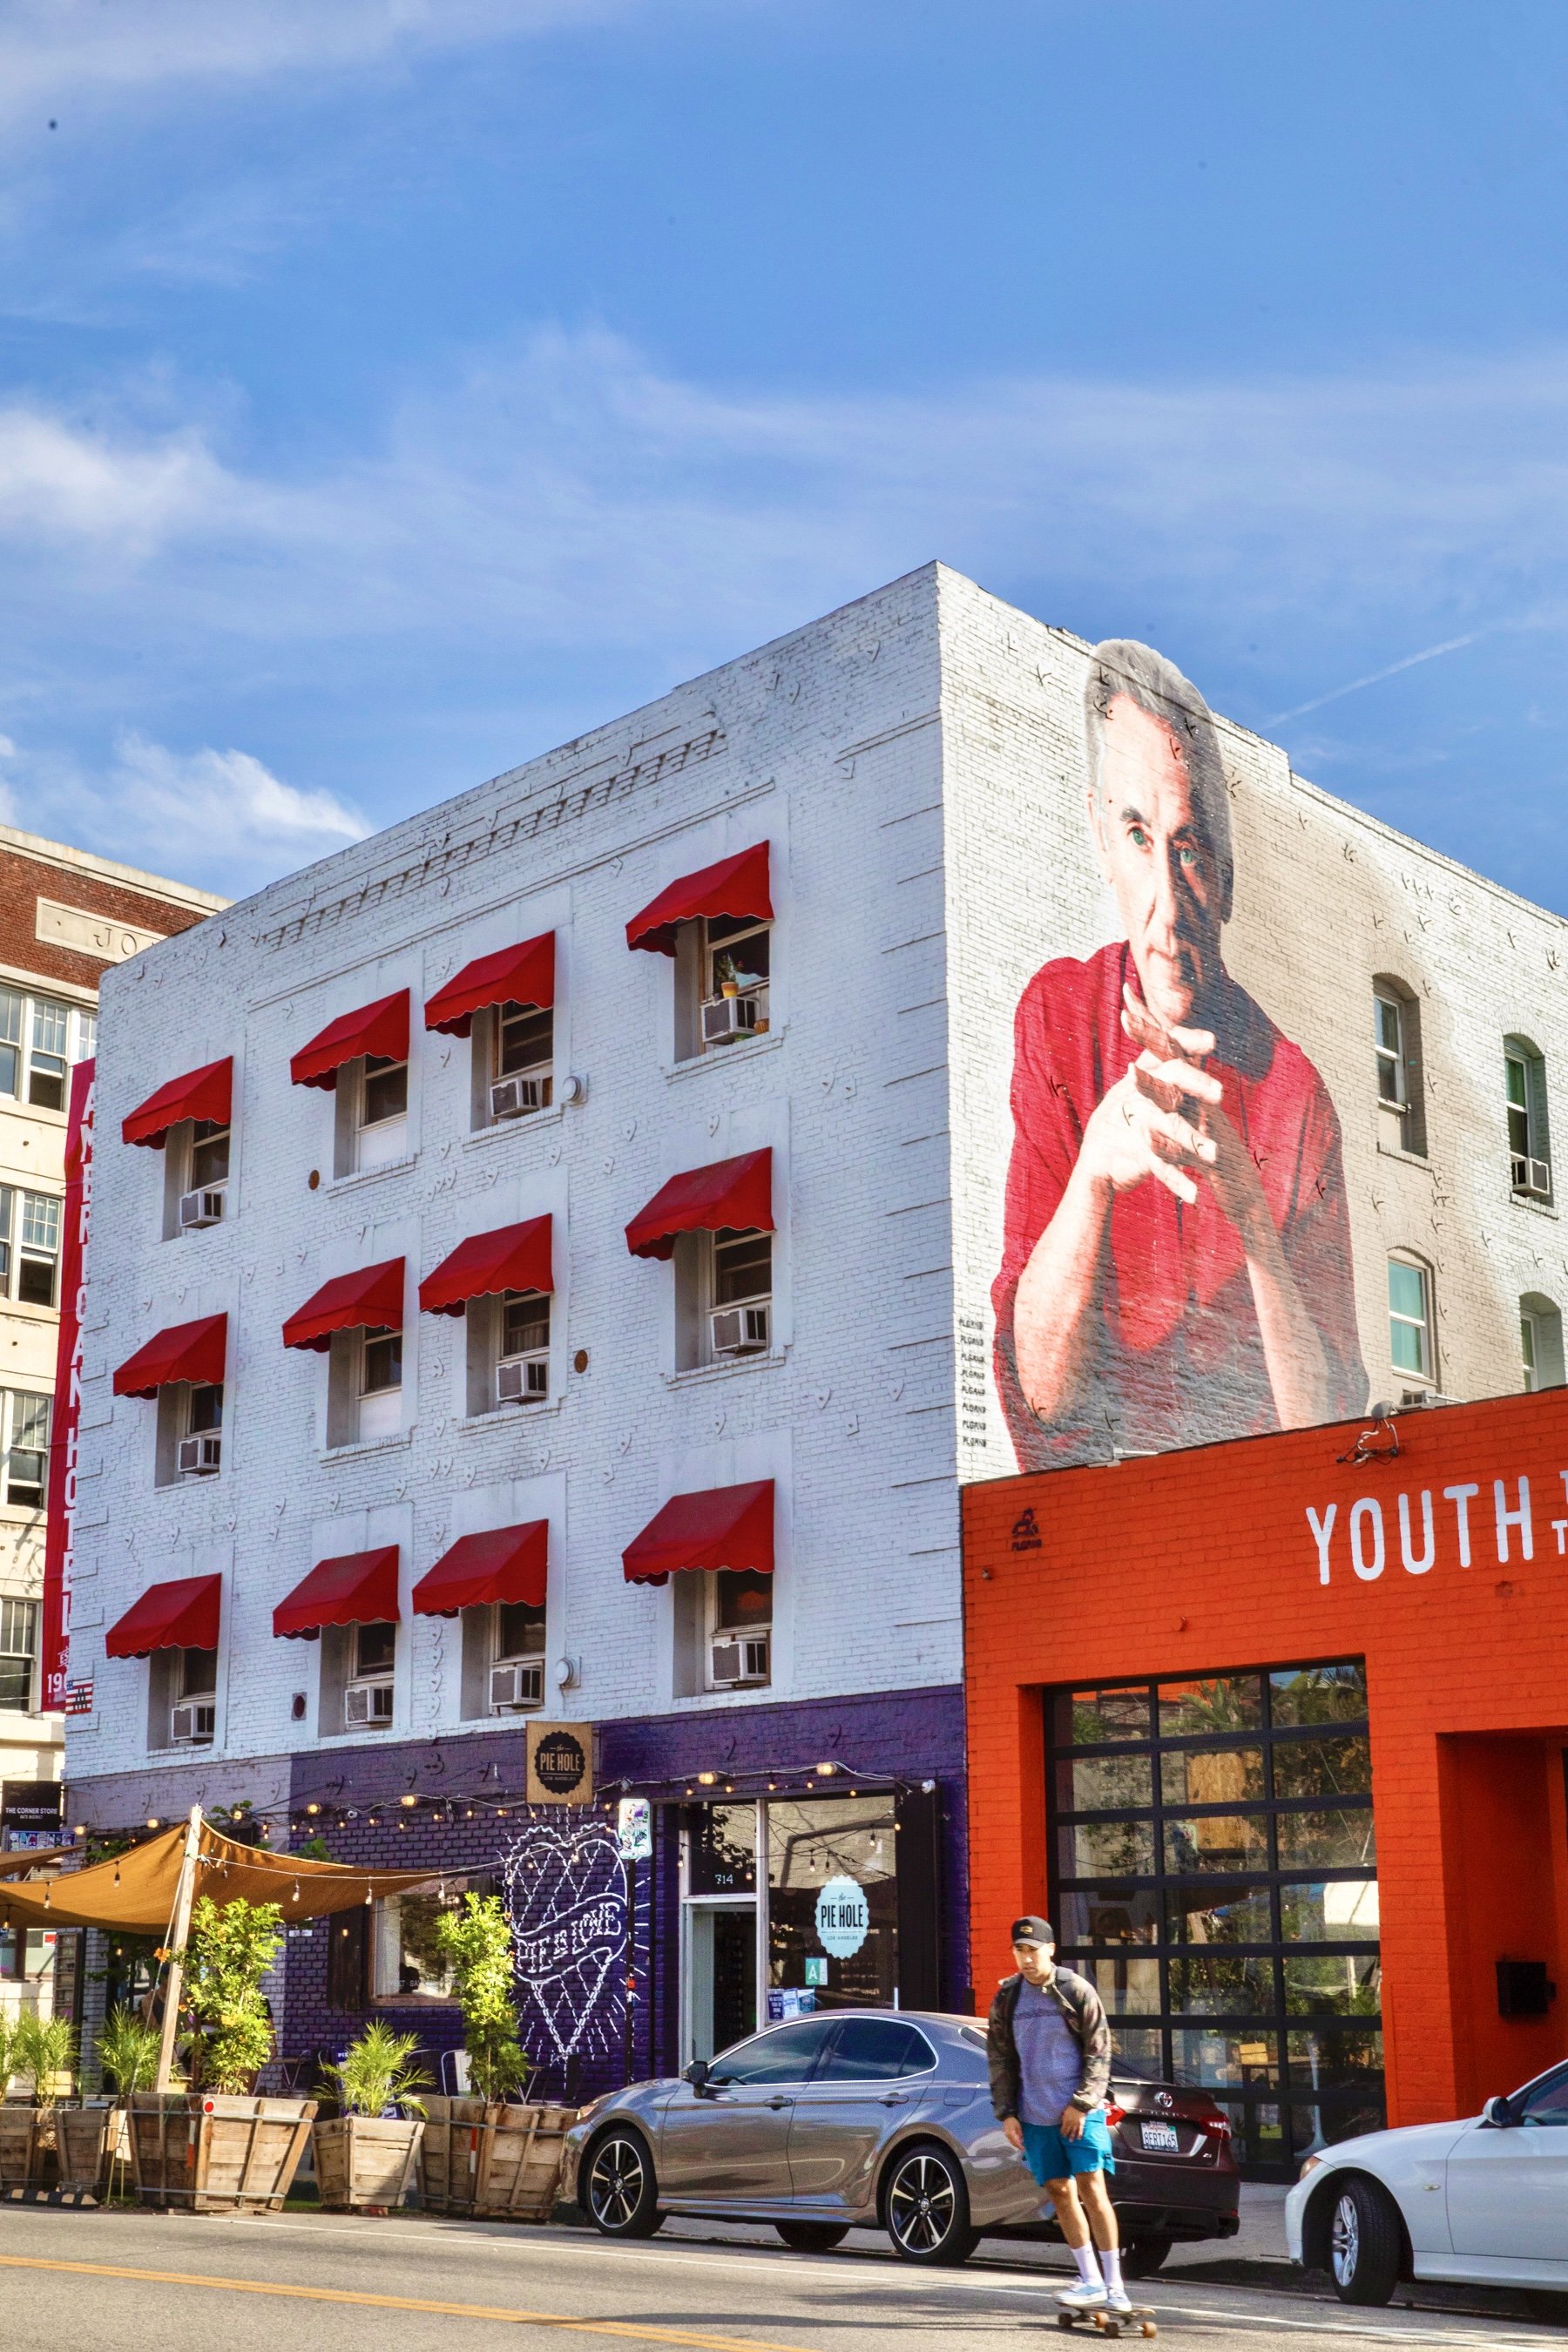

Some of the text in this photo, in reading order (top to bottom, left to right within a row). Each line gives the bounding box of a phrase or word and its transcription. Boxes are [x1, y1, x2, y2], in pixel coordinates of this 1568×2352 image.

[93, 928, 154, 955] JO
[1306, 1476, 1533, 1585] YOUTH
[540, 1753, 581, 1771] PIE HOLE
[714, 1874, 733, 1884] 714
[821, 1904, 863, 1928] PIE HOLE
[516, 1936, 552, 1973] PIE
[571, 1902, 621, 1955] LOVE
[808, 1964, 818, 1980] A
